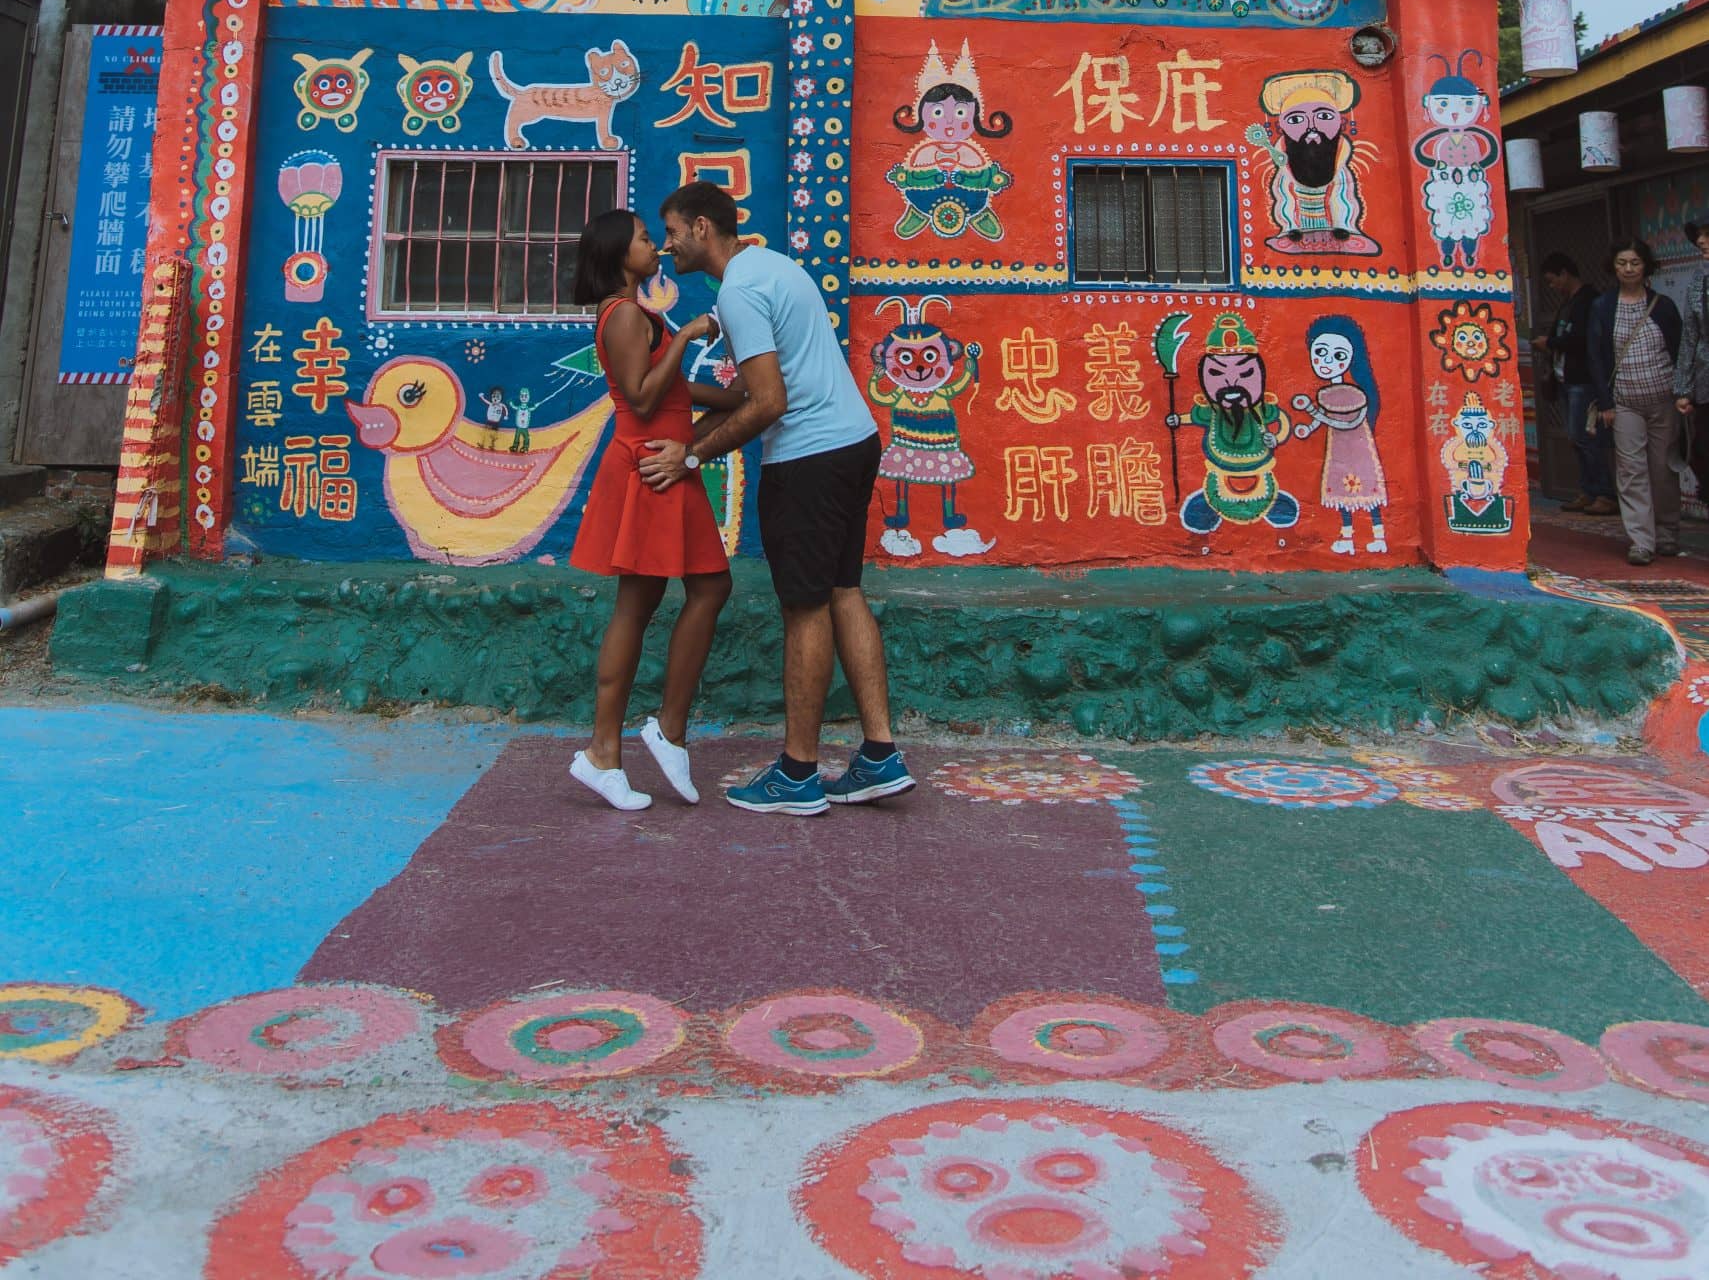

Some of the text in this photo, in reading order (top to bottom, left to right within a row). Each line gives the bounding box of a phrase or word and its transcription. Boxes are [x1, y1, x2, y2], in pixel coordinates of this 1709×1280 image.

[104, 55, 118, 63] NO
[1053, 48, 1228, 134] 保庇
[240, 323, 283, 487] 在雲端
[280, 317, 357, 521] 幸福
